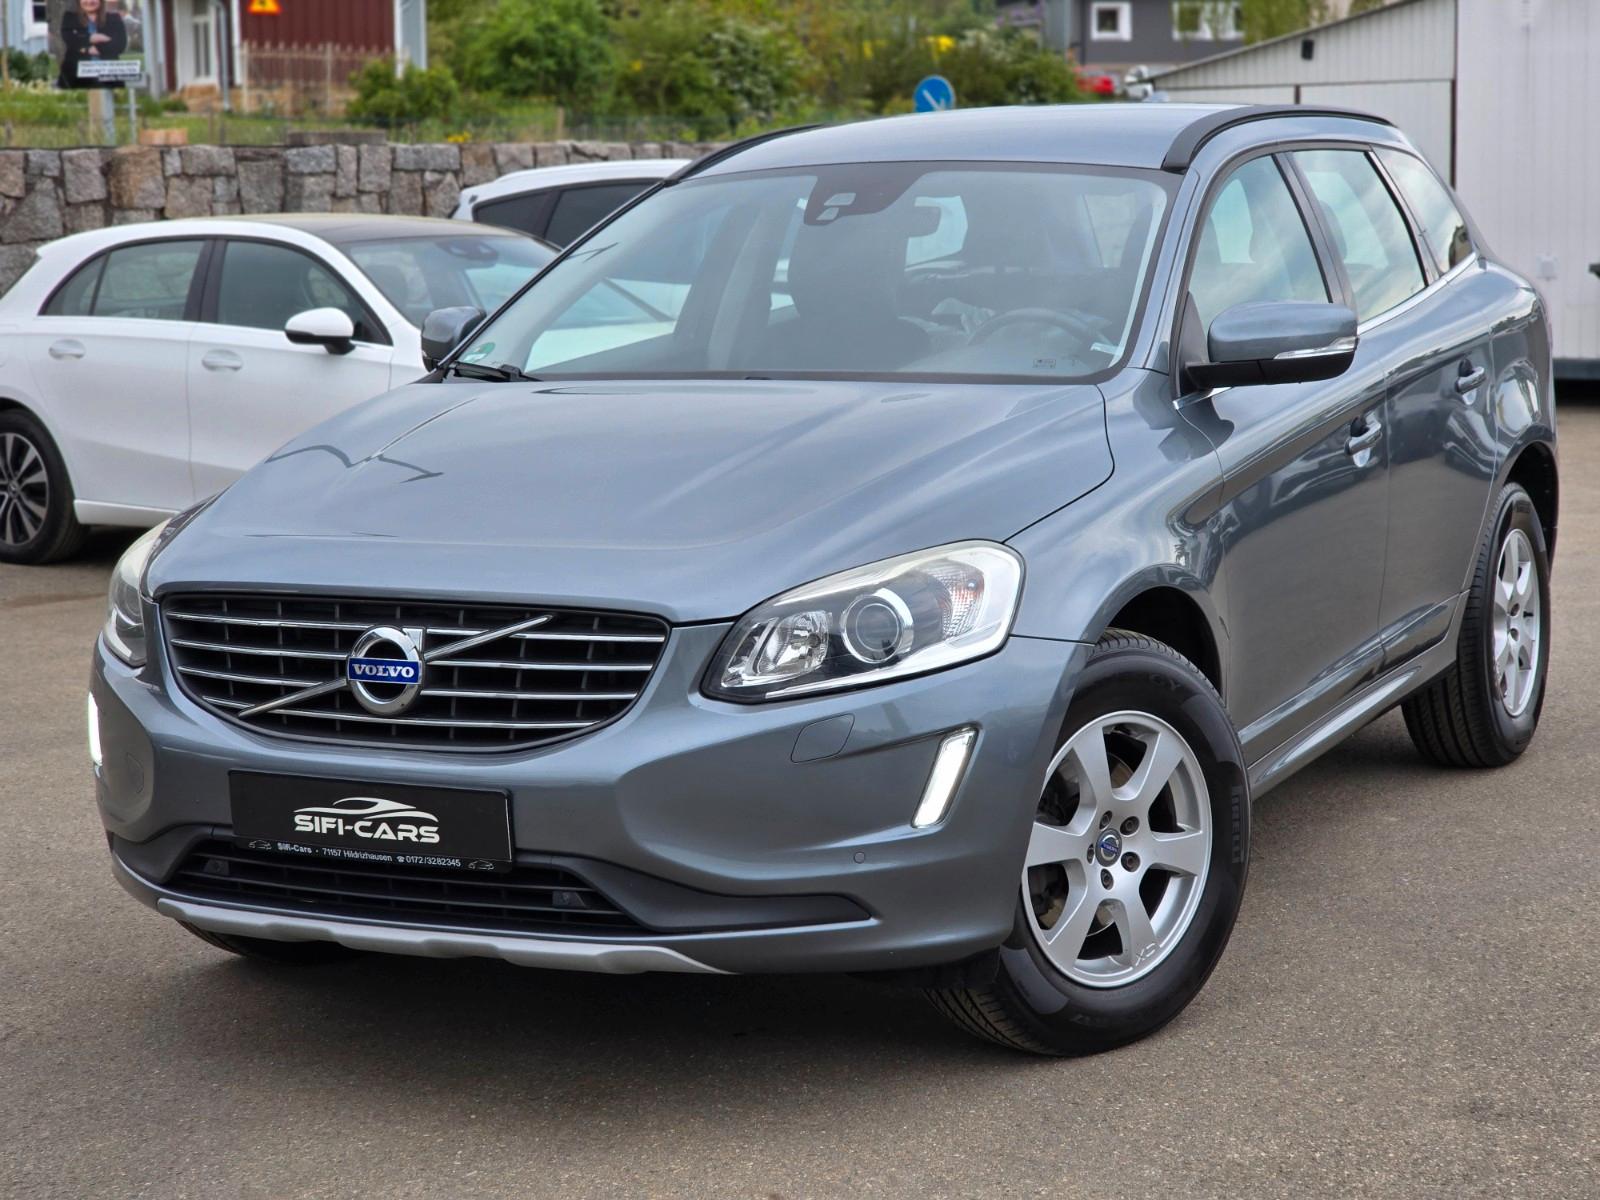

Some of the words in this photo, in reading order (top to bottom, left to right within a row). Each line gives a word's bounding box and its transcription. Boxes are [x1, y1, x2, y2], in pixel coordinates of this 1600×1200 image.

[352, 663, 414, 678] VOLVO
[294, 814, 440, 844] SIFI-CARS
[322, 846, 342, 857] 71157
[343, 848, 393, 862] Hildrizhausen
